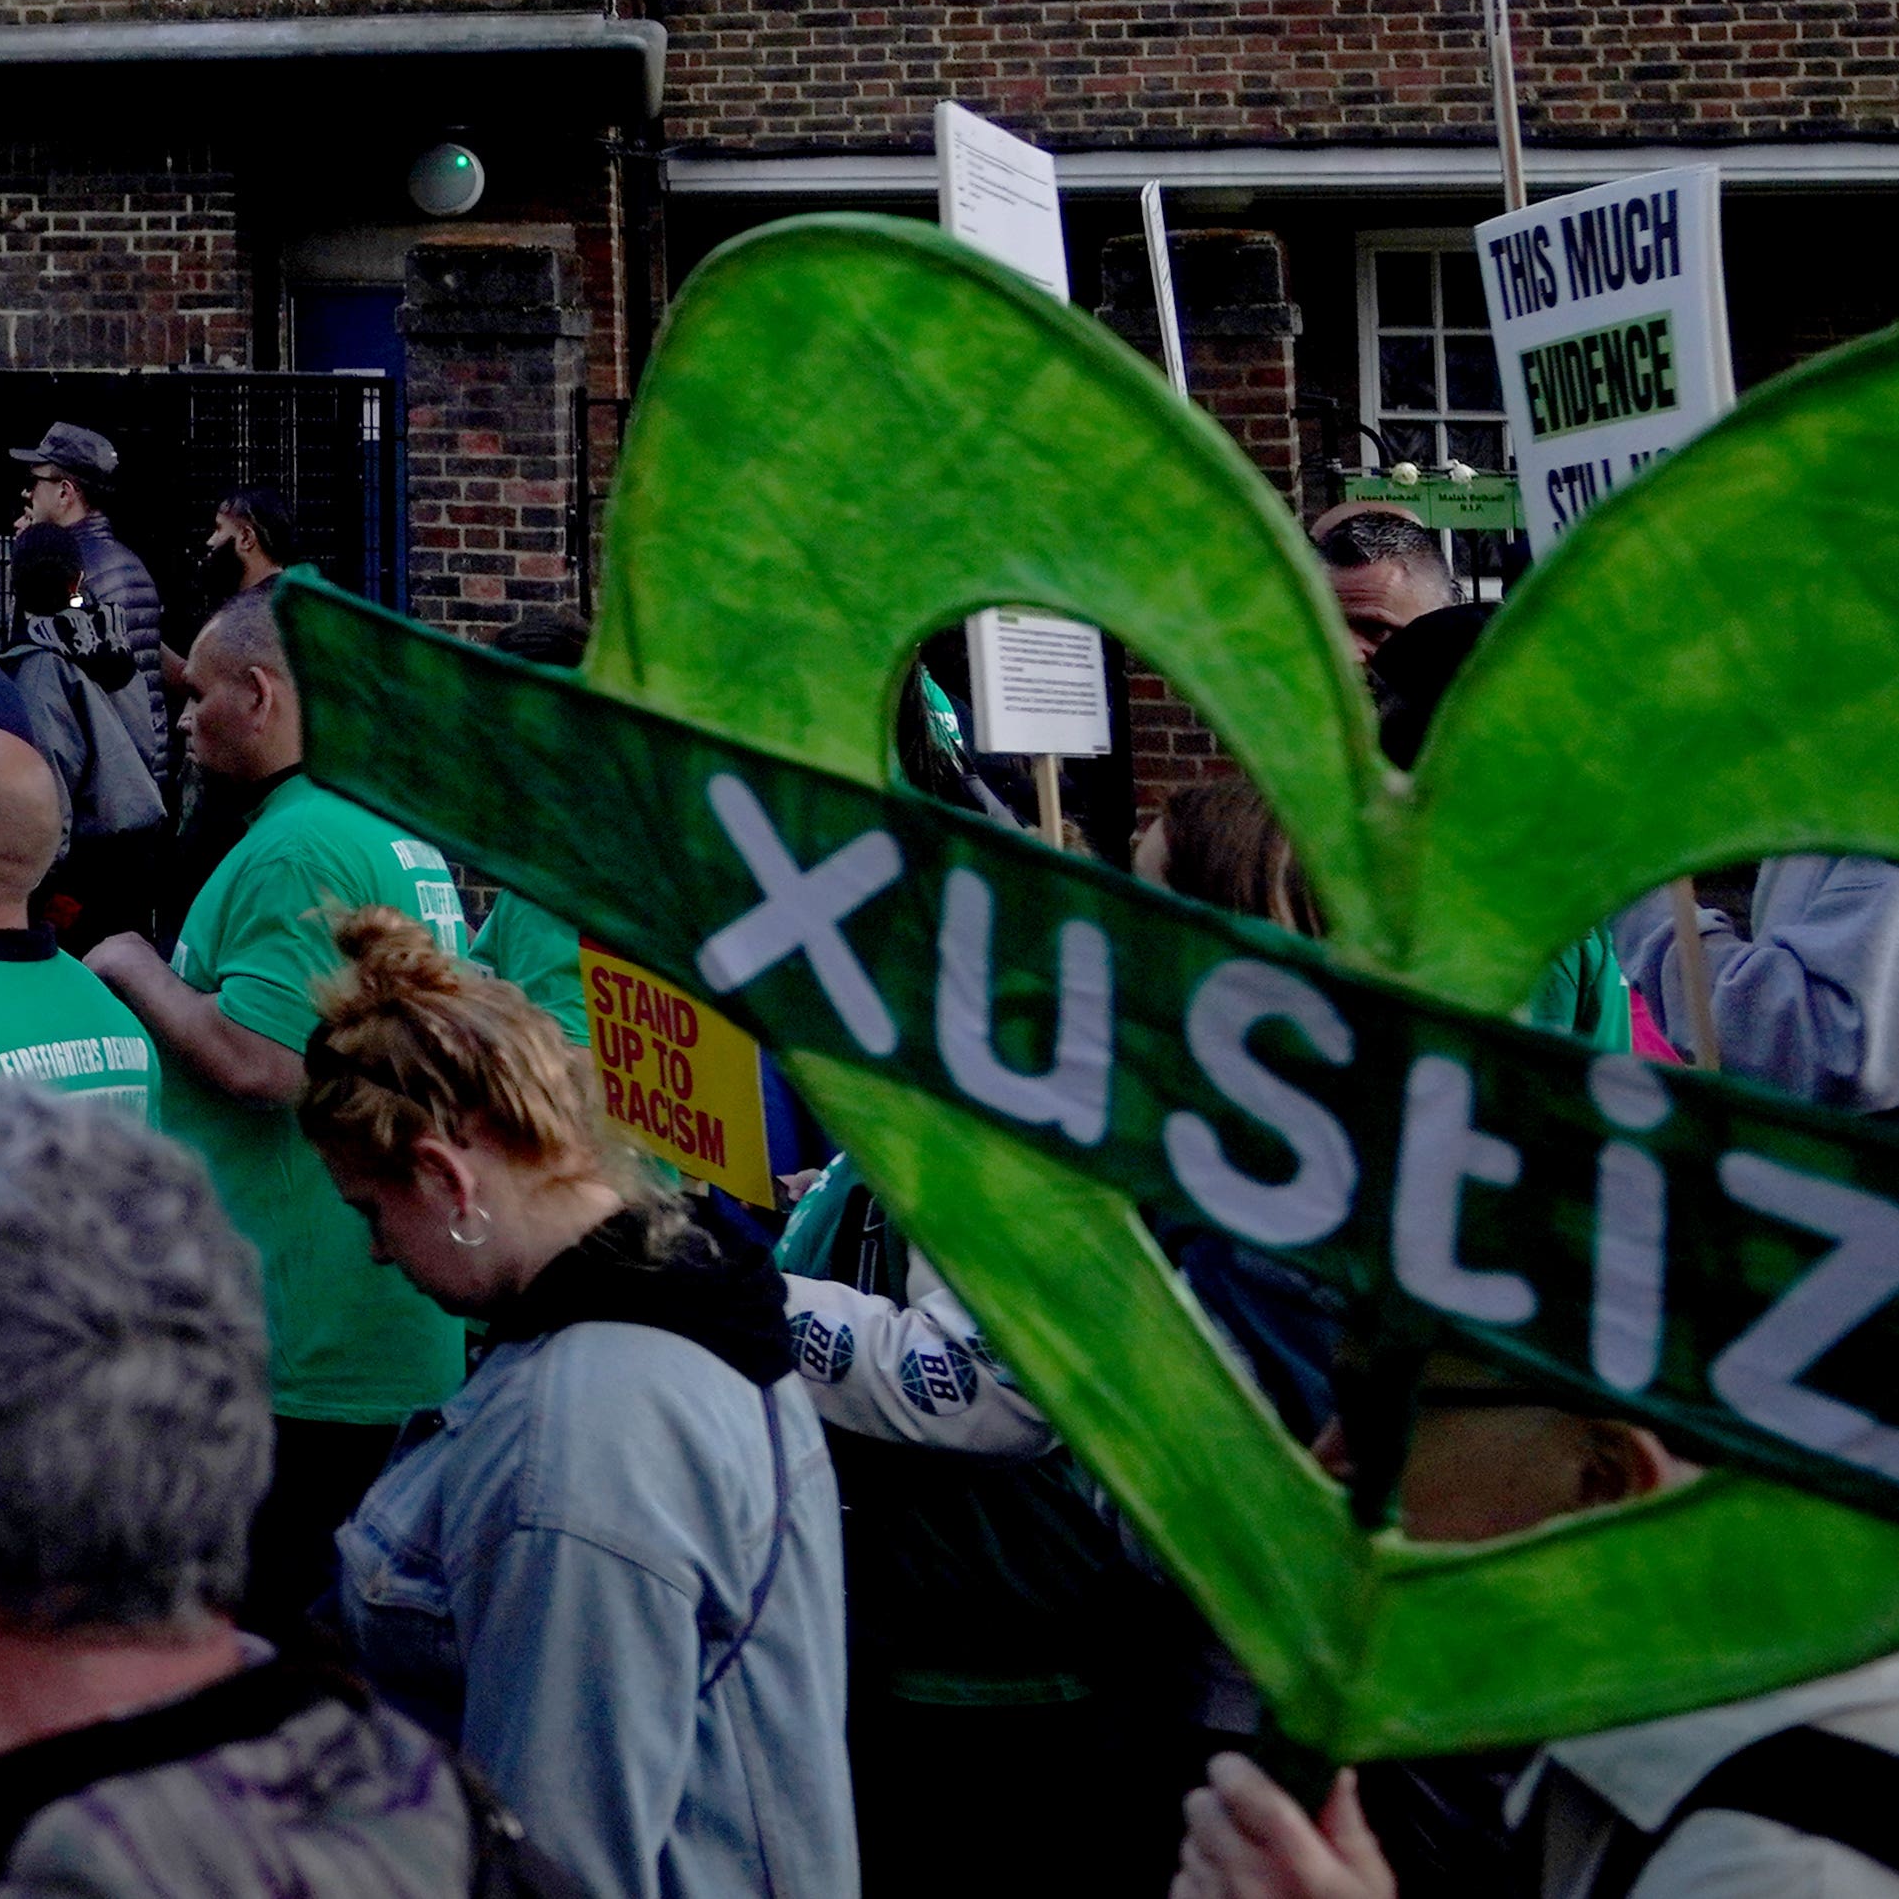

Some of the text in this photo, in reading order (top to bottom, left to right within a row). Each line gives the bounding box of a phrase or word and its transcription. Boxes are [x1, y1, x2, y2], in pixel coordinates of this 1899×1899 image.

[1489, 189, 1681, 321] THIS MUCH
[1520, 318, 1677, 436] EVIDENCE
[591, 965, 699, 1048] STAND
[596, 1016, 694, 1102] UP TO
[602, 1068, 726, 1168] RACISM
[803, 1318, 834, 1376] BB
[920, 1353, 961, 1403] BB
